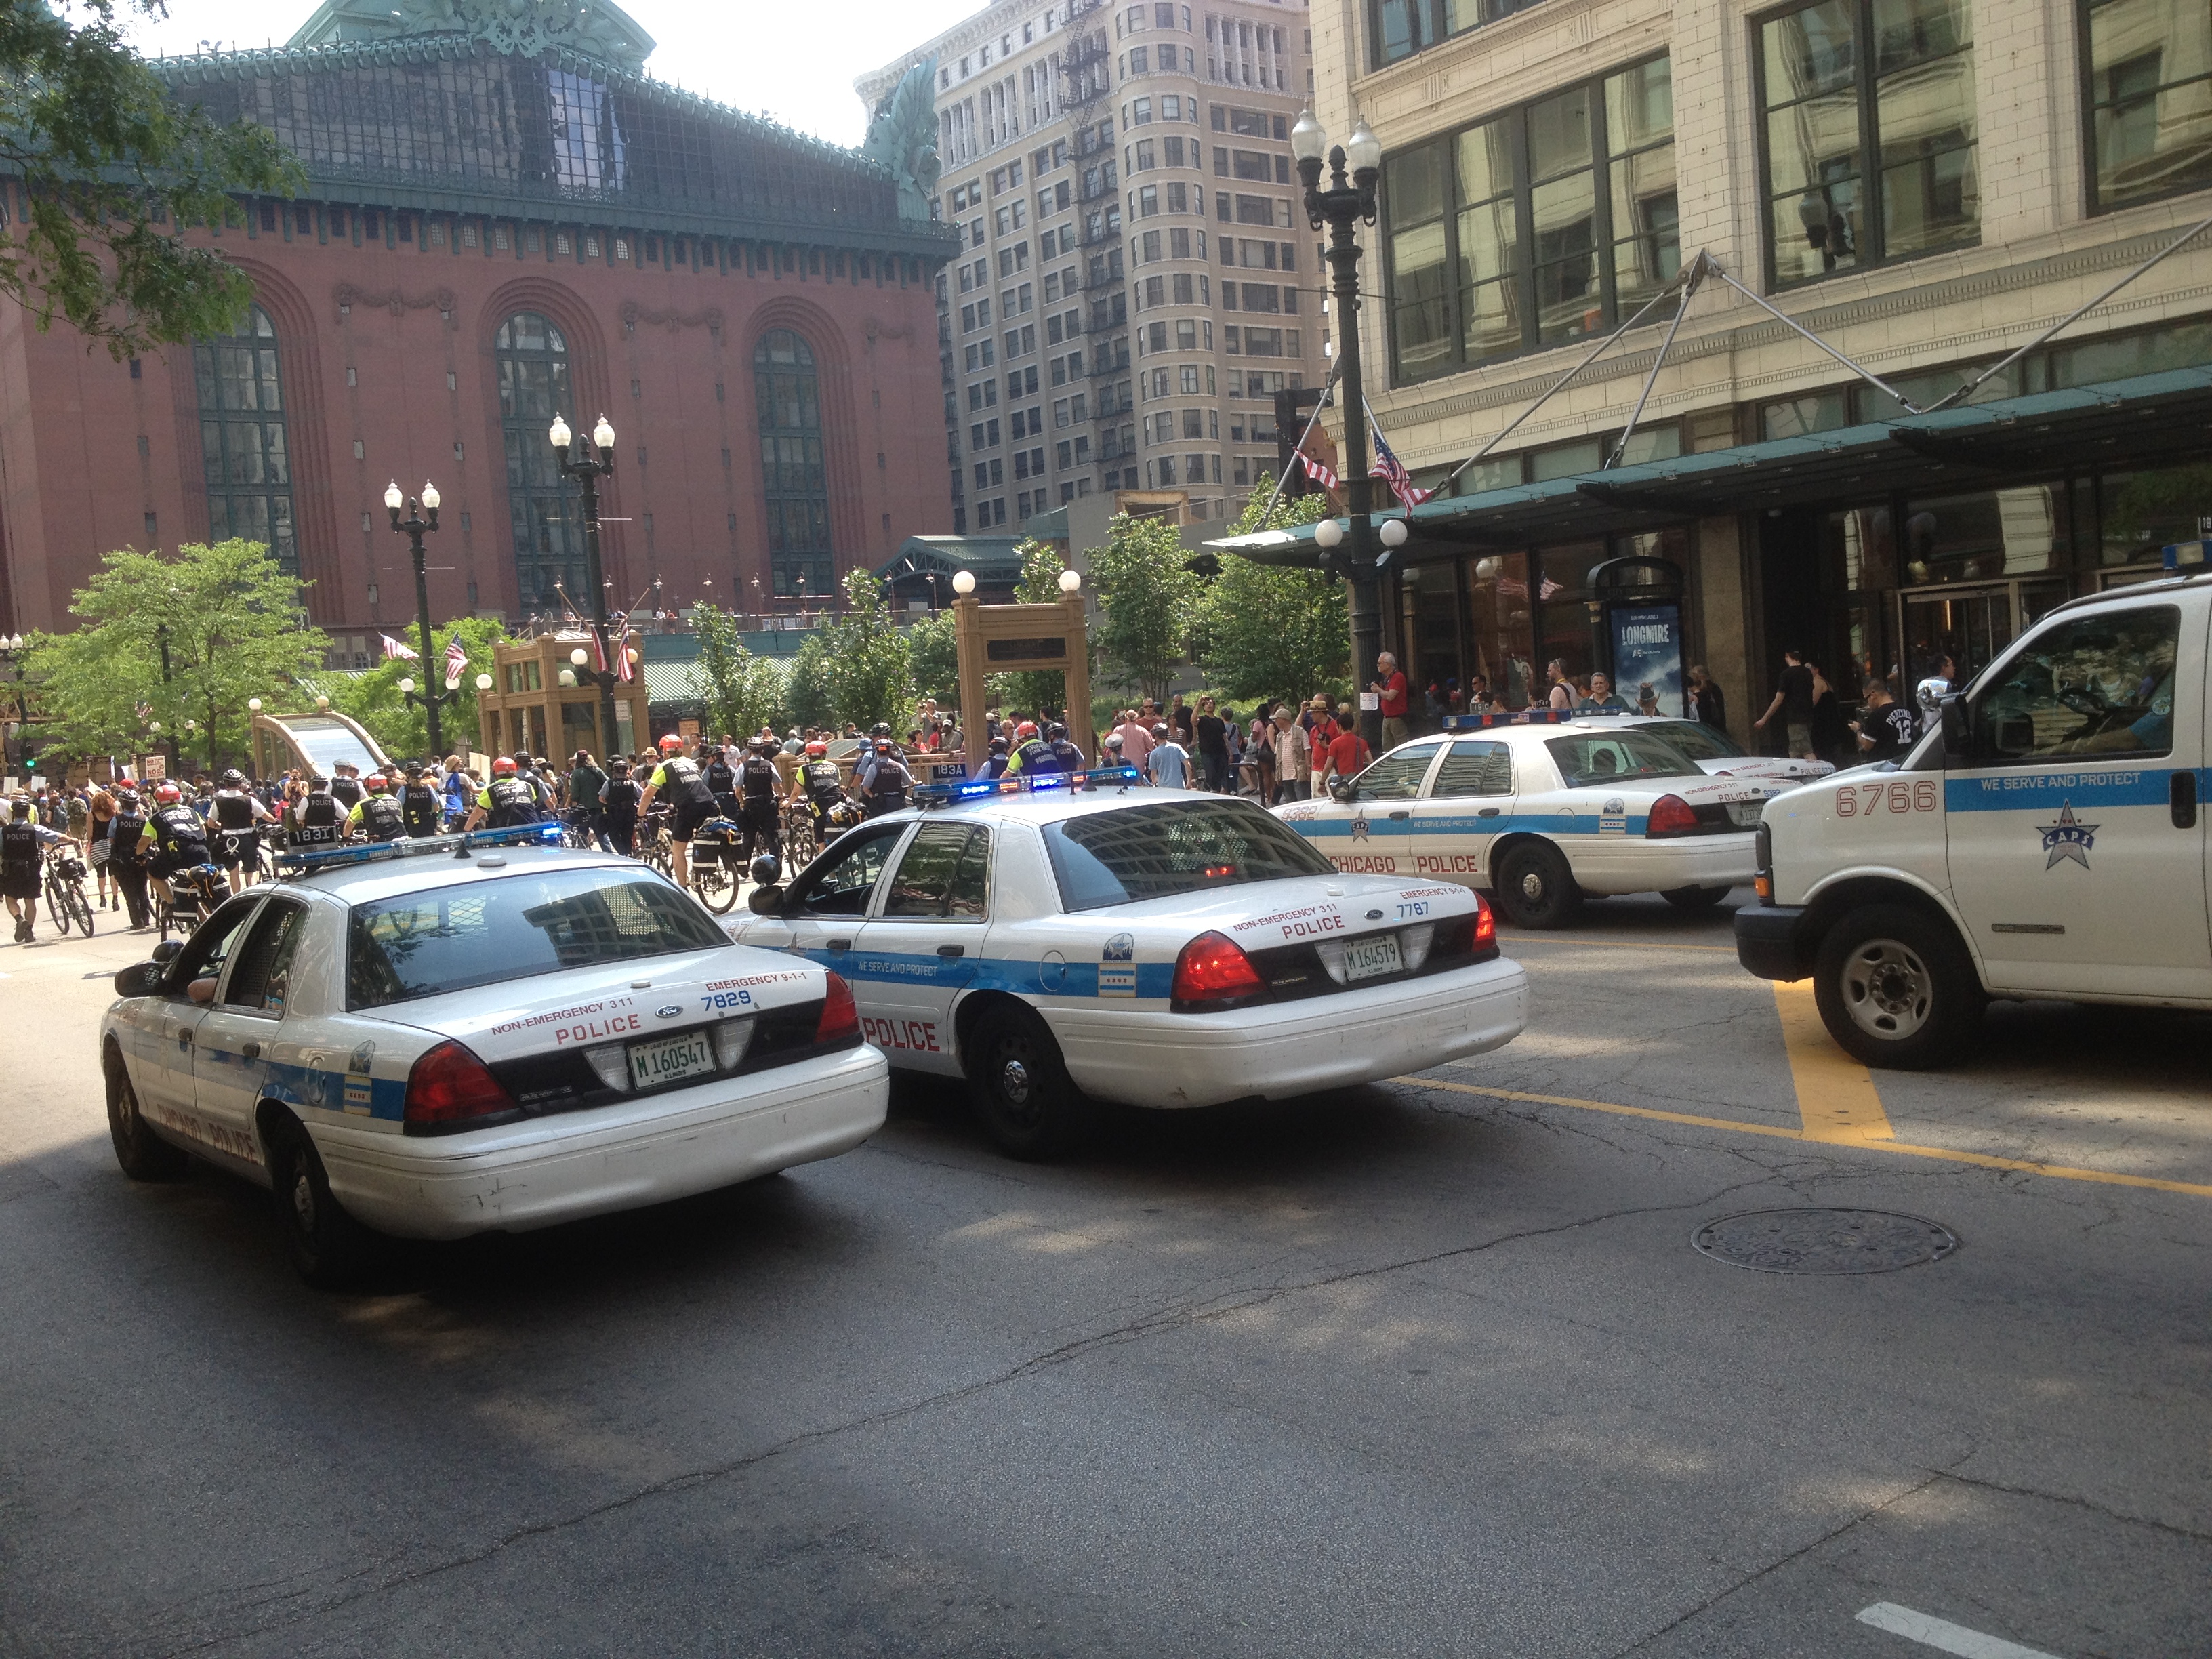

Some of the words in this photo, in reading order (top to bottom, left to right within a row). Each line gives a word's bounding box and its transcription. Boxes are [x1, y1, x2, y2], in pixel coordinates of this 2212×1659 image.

[1621, 623, 1670, 646] LONGMIRE
[1896, 720, 1912, 744] 12
[937, 765, 962, 775] 183A
[1800, 767, 1821, 775] POLICE
[1981, 779, 2000, 791] WE
[2003, 777, 2045, 790] SERVE
[2047, 775, 2076, 787] AND
[2079, 773, 2141, 787] PROTECT
[312, 798, 332, 806] POLICE
[1718, 792, 1750, 802] POLICE
[1835, 780, 1937, 817] 6766
[1281, 805, 1319, 821] 9382
[7, 833, 30, 841] POLICE
[2045, 830, 2090, 846] CAPS
[1330, 855, 1396, 873] CHICAGO
[1417, 855, 1478, 873] POLICE
[1400, 887, 1449, 899] EMERGENCY
[1233, 907, 1316, 933] NON-EMERGENCY
[1319, 903, 1338, 913] 311
[1396, 901, 1429, 918] 7787
[1281, 915, 1345, 939] POLICE
[1346, 950, 1357, 970] M
[1357, 943, 1396, 968] 164579
[858, 961, 867, 971] WE
[869, 962, 890, 973] SERVE
[890, 962, 905, 974] AND
[906, 964, 938, 977] PROTECT
[705, 975, 779, 992] EMERGENCY
[781, 972, 808, 981] 9-1-1
[701, 990, 752, 1012] 7829
[491, 1002, 604, 1036] NON-EMERGENCY
[609, 997, 633, 1009] 311
[555, 1013, 641, 1045] POLICE
[862, 1017, 940, 1052] POLICE
[636, 1054, 649, 1078] M
[651, 1040, 706, 1075] 160547
[208, 1122, 259, 1166] POLICE
